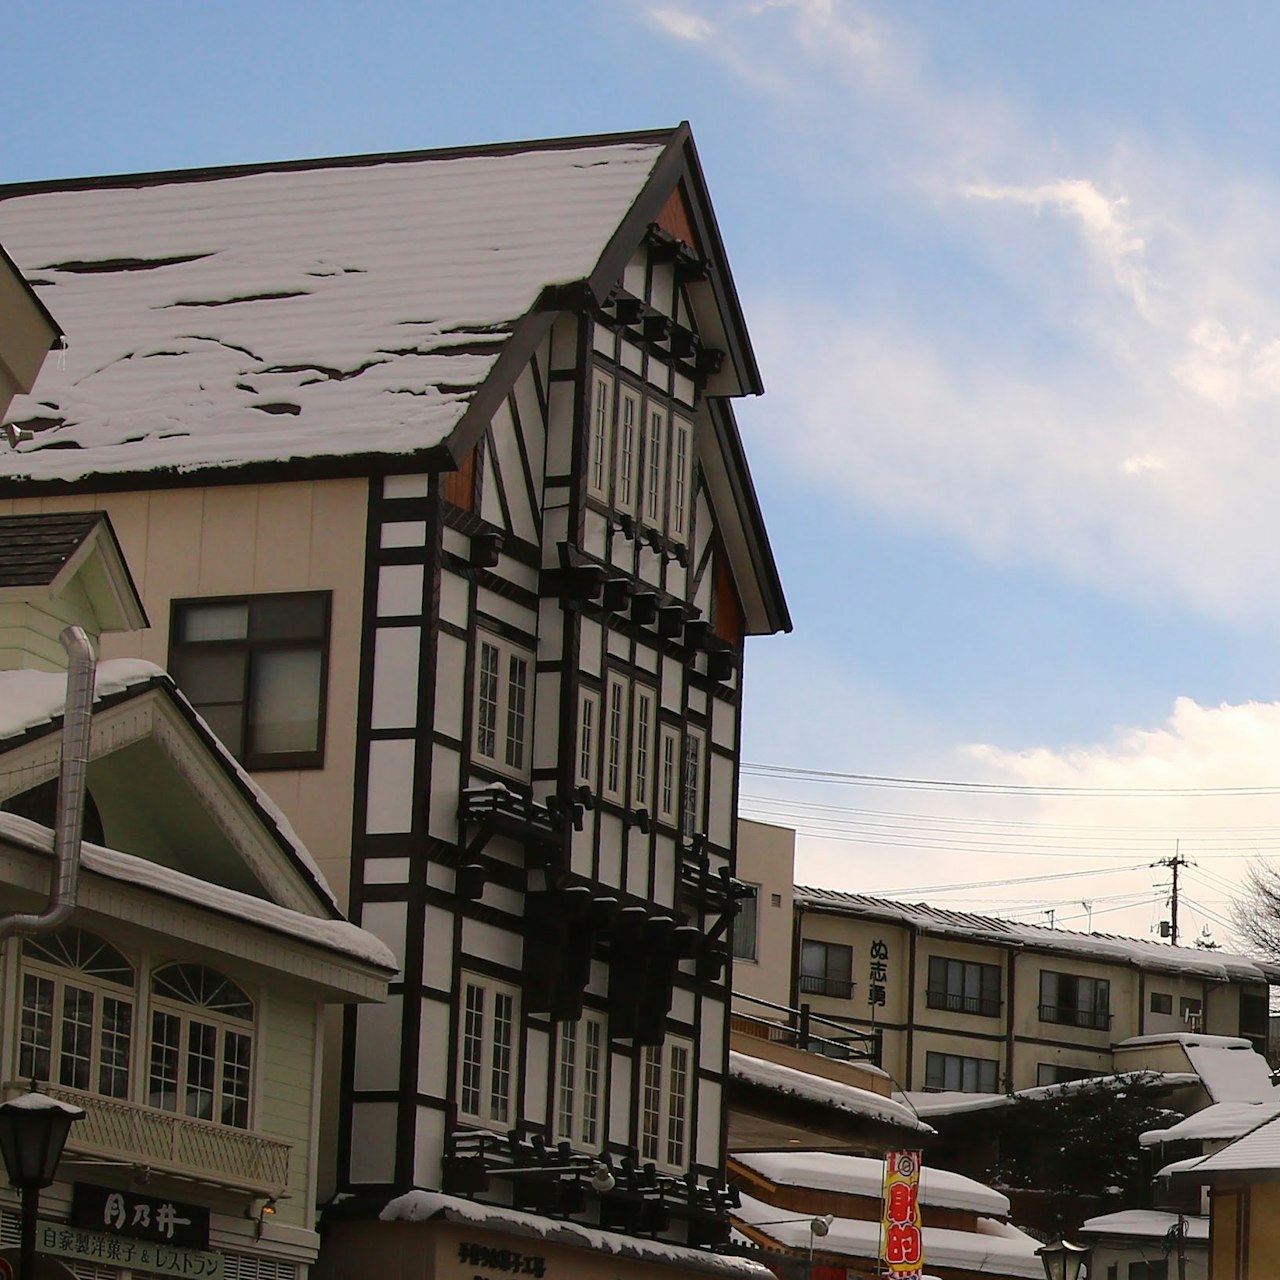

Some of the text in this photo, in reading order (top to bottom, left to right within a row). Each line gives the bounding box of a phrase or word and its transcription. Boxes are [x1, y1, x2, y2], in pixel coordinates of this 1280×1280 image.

[868, 940, 888, 1007] ぬ志勇
[104, 1192, 191, 1238] 月乃井
[887, 1182, 920, 1263] 射的
[43, 1227, 218, 1275] 自家製洋菓子 & レストラン
